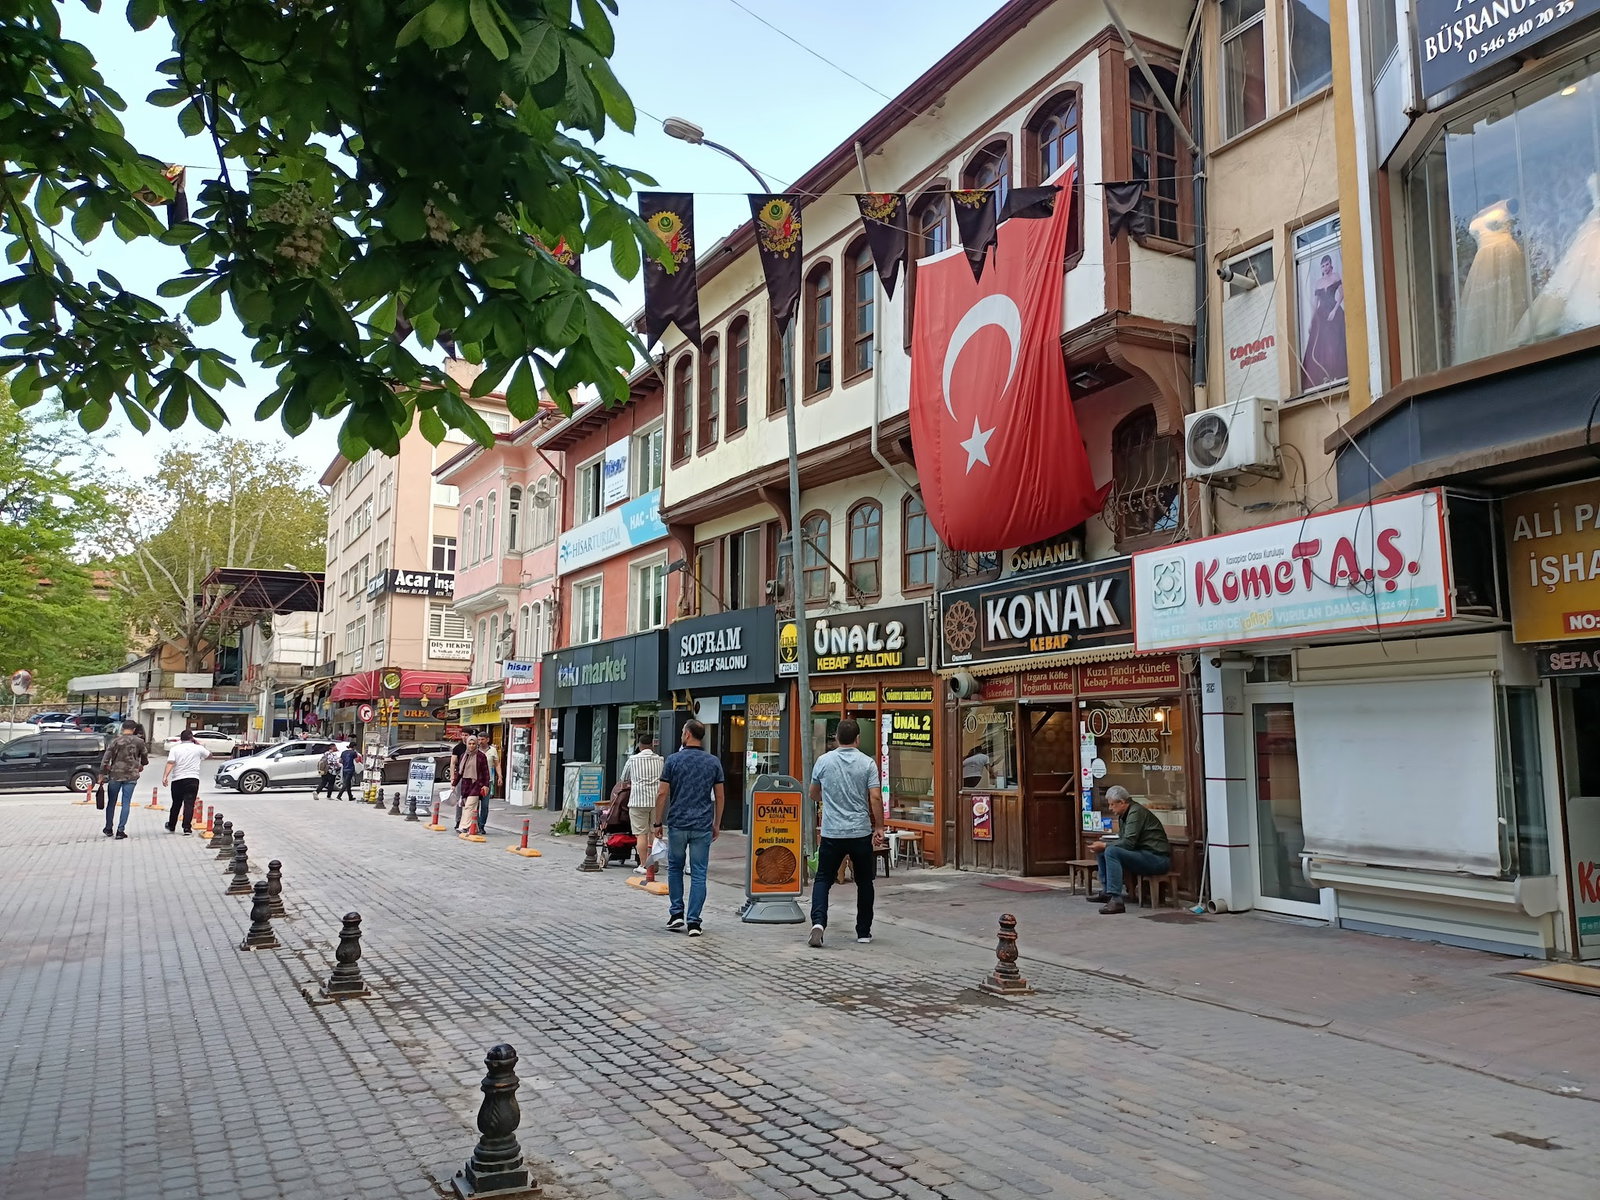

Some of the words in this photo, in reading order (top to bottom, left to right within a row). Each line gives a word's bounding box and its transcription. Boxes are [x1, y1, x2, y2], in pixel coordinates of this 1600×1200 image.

[1468, 49, 1477, 63] 0
[1481, 34, 1505, 57] 546
[1507, 19, 1533, 42] 840
[1535, 8, 1554, 28] 20
[1556, 0, 1574, 17] 35
[1513, 502, 1563, 541] ALİ
[1008, 540, 1079, 572] OSMANLI
[394, 569, 431, 588] Acar
[986, 578, 1120, 642] KONAK
[680, 626, 741, 657] SOFRAM
[814, 619, 884, 656] ÜNAL
[885, 620, 905, 650] 2
[1029, 634, 1070, 652] KEBAP
[507, 662, 532, 671] hisar
[581, 654, 627, 685] market
[676, 660, 690, 675] AİLE
[691, 658, 714, 674] KEBAP
[715, 655, 747, 671] SALONU
[817, 656, 849, 671] KEBAP
[855, 651, 902, 668] SALONU
[1549, 651, 1593, 671] SEFA
[1049, 671, 1068, 680] Köfte
[1086, 667, 1107, 677] Kuzu
[1023, 682, 1051, 693] Yoğurtlu
[1053, 682, 1073, 690] Köfte
[403, 709, 431, 718] URFA
[893, 712, 920, 729] ÜNAL
[922, 715, 931, 731] 2
[1087, 706, 1172, 737] OSMANLI
[1109, 728, 1159, 744] KONAK
[1110, 746, 1160, 764] KEBAP
[758, 805, 797, 818] OSMANLI
